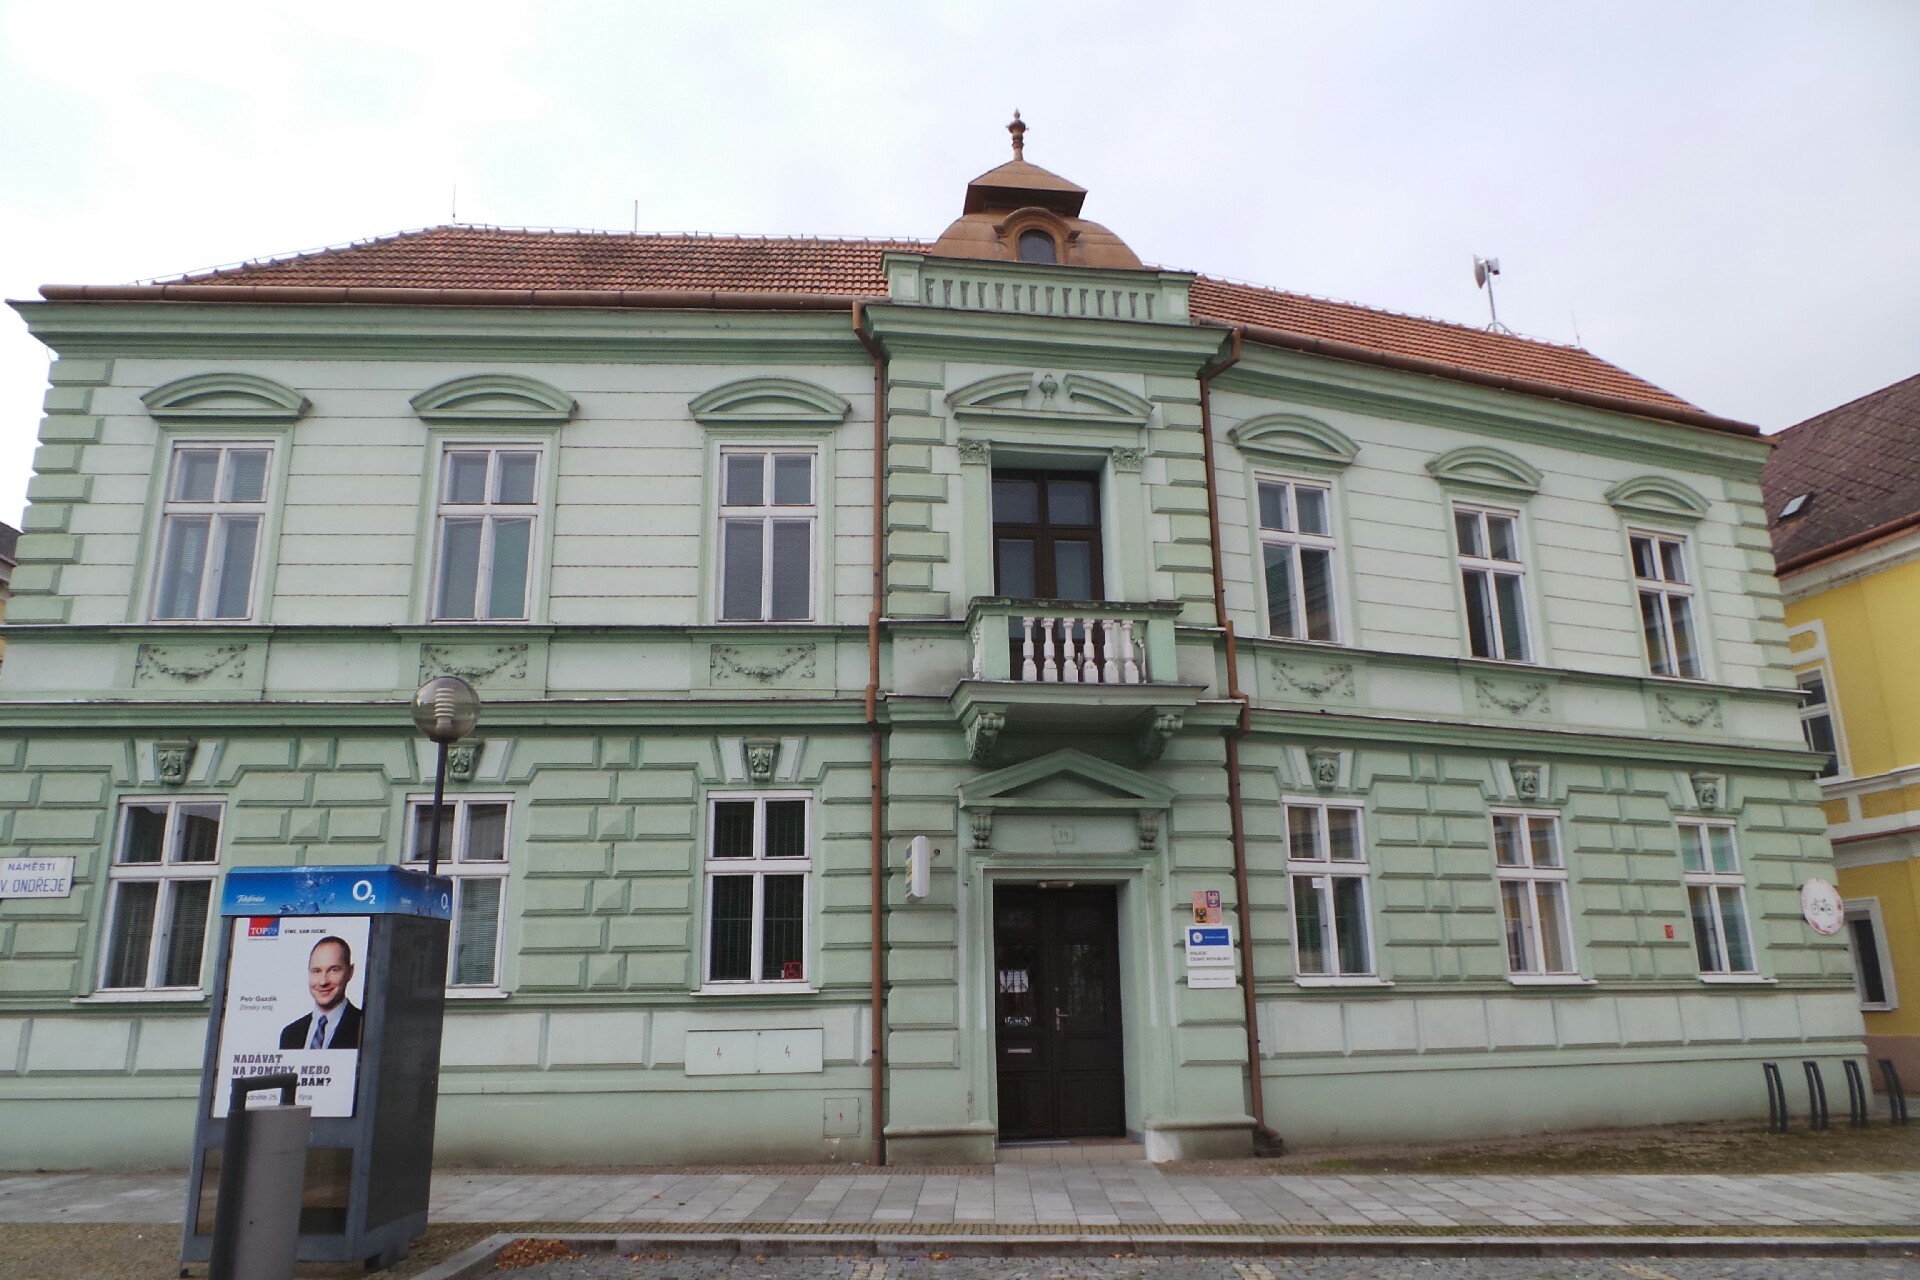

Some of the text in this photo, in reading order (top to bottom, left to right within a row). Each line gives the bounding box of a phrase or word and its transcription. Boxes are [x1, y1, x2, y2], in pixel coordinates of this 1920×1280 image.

[13, 877, 66, 893] ONDŘEJE
[233, 1052, 283, 1063] NADÁVAT
[232, 1066, 246, 1075] NA
[300, 1065, 330, 1075] NEBO
